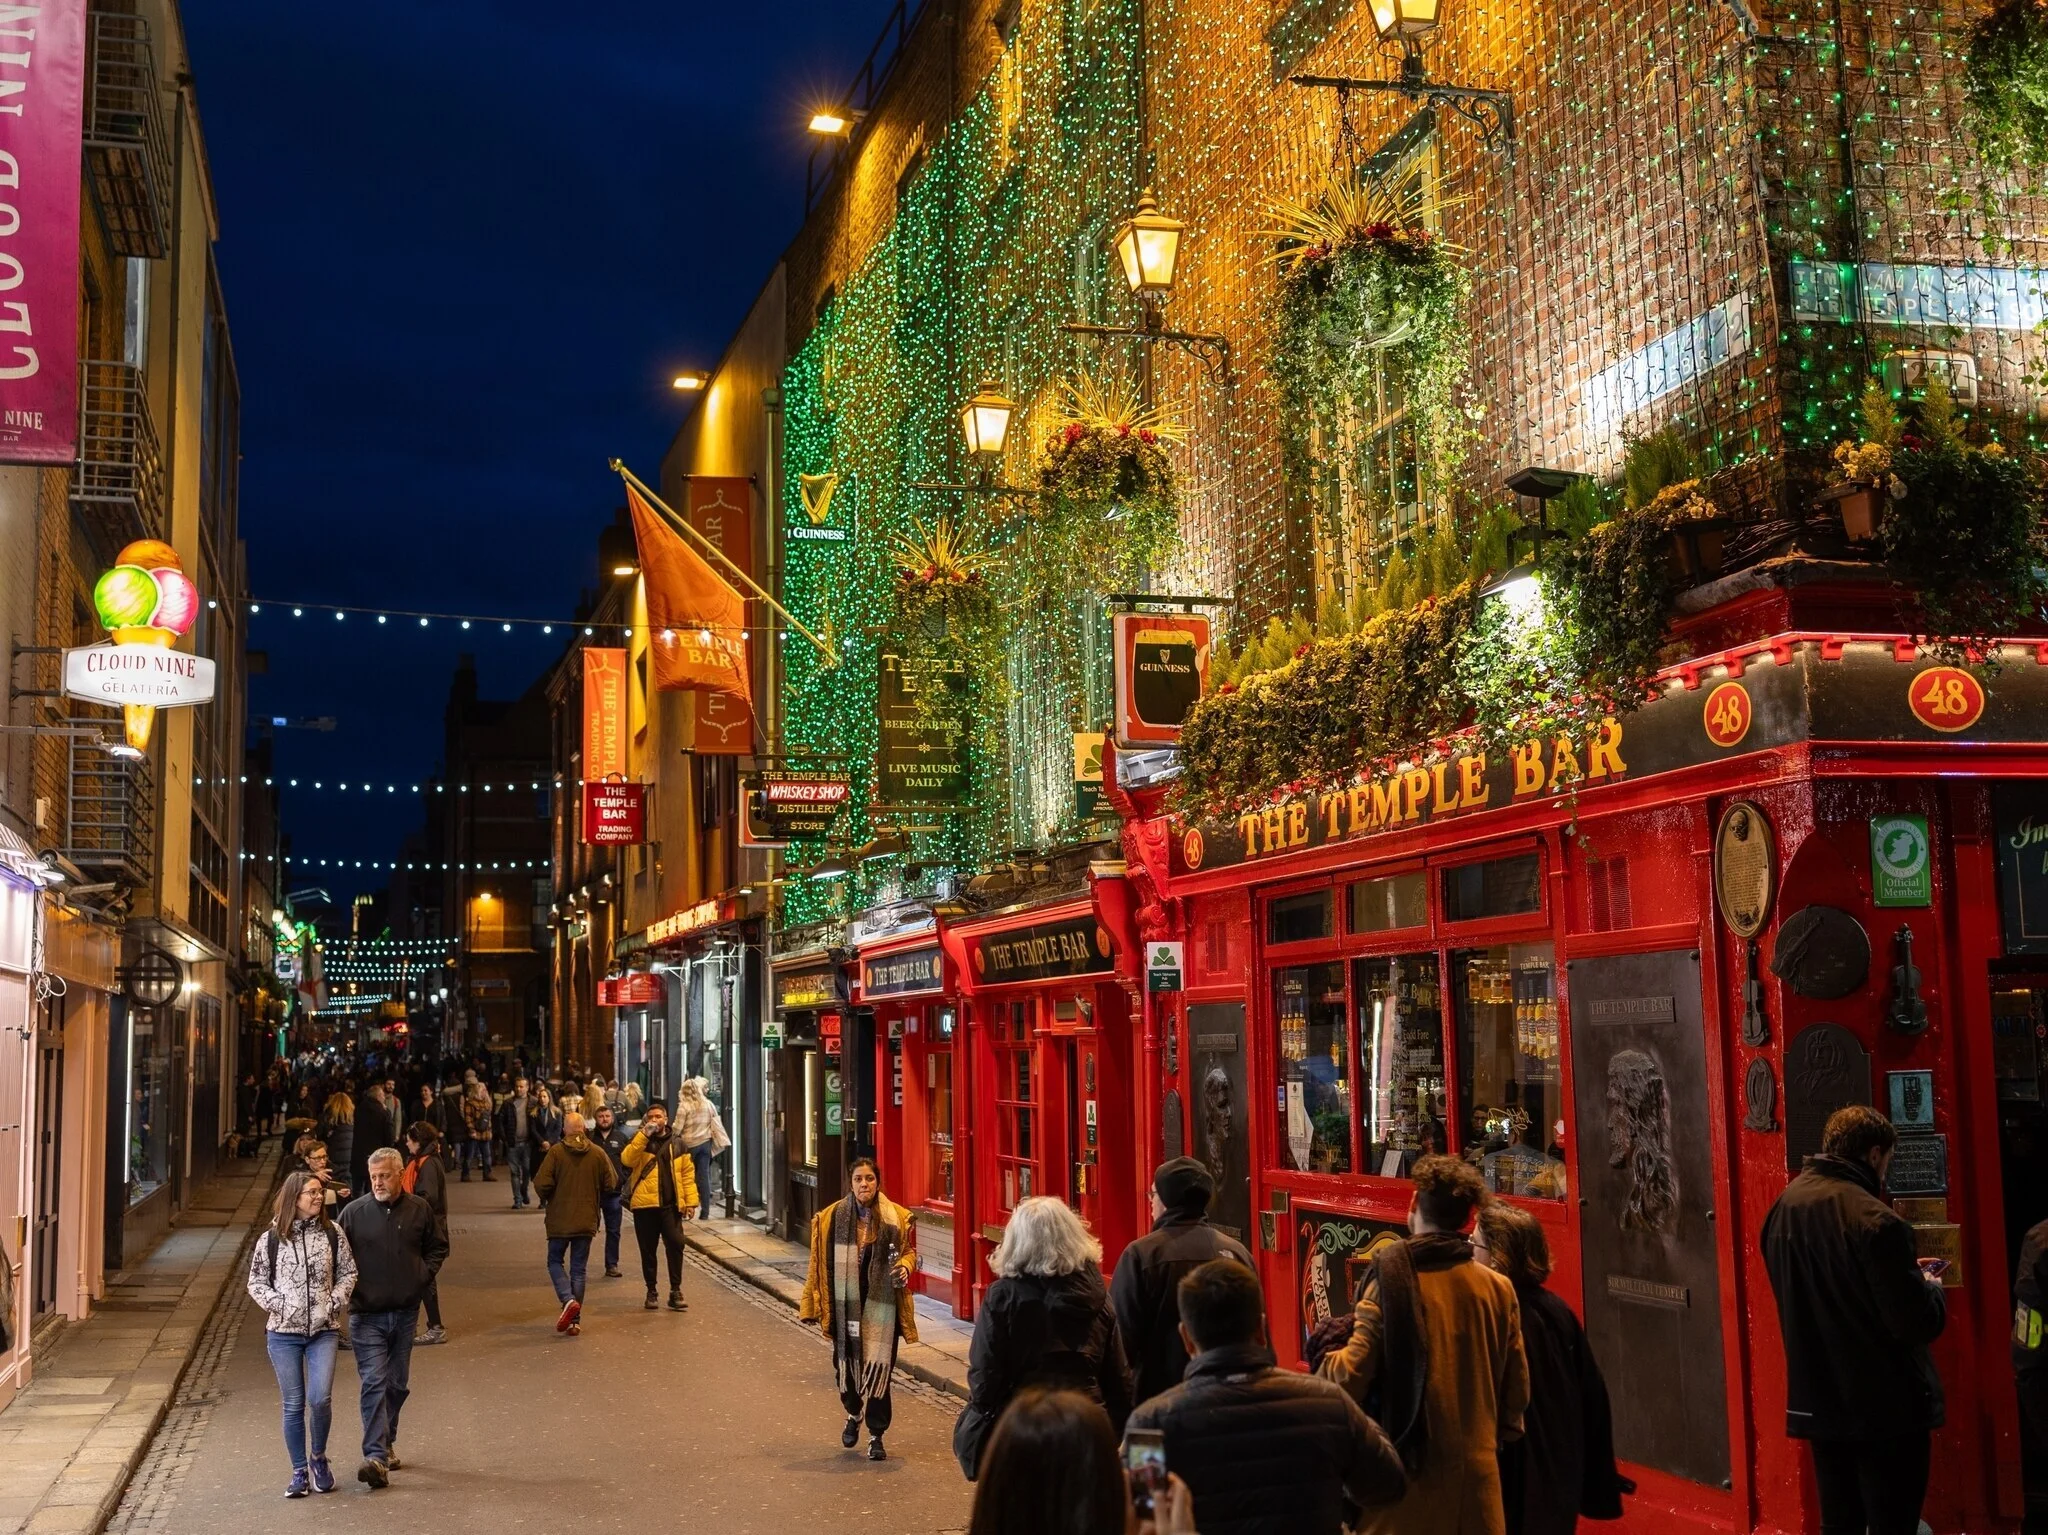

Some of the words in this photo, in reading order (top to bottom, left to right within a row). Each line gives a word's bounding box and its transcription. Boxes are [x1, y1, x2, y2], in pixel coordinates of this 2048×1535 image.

[5, 410, 43, 431] NINE
[793, 527, 845, 540] GUINNESS
[87, 653, 146, 673] CLOUD
[154, 656, 196, 678] NINE
[688, 649, 732, 670] BAR
[1140, 663, 1190, 673] GUINNESS
[102, 682, 179, 697] GELATERIA
[603, 677, 617, 710] THE
[1921, 676, 1967, 715] 48
[1711, 695, 1742, 736] 48
[884, 719, 914, 729] BEER
[916, 719, 963, 730] GARDEN
[591, 711, 600, 763] TRADING
[888, 764, 918, 773] LIVE
[920, 764, 961, 774] MUSIC
[762, 771, 783, 780] THE
[785, 771, 827, 781] TEMPLE
[830, 772, 851, 782] BAR
[905, 778, 945, 787] DAILY
[604, 786, 626, 796] THE
[769, 785, 817, 800] WHISKEY
[817, 785, 845, 799] SHOP
[1239, 802, 1310, 856] THE
[1321, 752, 1490, 838] TEMPLE
[1510, 716, 1627, 796] BAR
[593, 798, 637, 808] TEMPLE
[777, 804, 839, 814] DISTILLERY
[602, 809, 627, 819] BAR
[597, 825, 632, 833] TRADING
[790, 822, 825, 830] STORE
[595, 833, 634, 841] COMPANY
[1189, 833, 1201, 862] 48
[1886, 878, 1919, 887] Official
[1884, 888, 1922, 897] Member
[990, 945, 1014, 970] THE
[1013, 935, 1060, 967] TEMPLE
[1059, 930, 1090, 960] BAR
[874, 967, 888, 986] THE
[888, 962, 914, 984] TEMPLE
[915, 960, 930, 980] BAR
[1591, 1002, 1608, 1015] THE
[1609, 999, 1648, 1014] TEMPLE
[1651, 998, 1673, 1012] BAR
